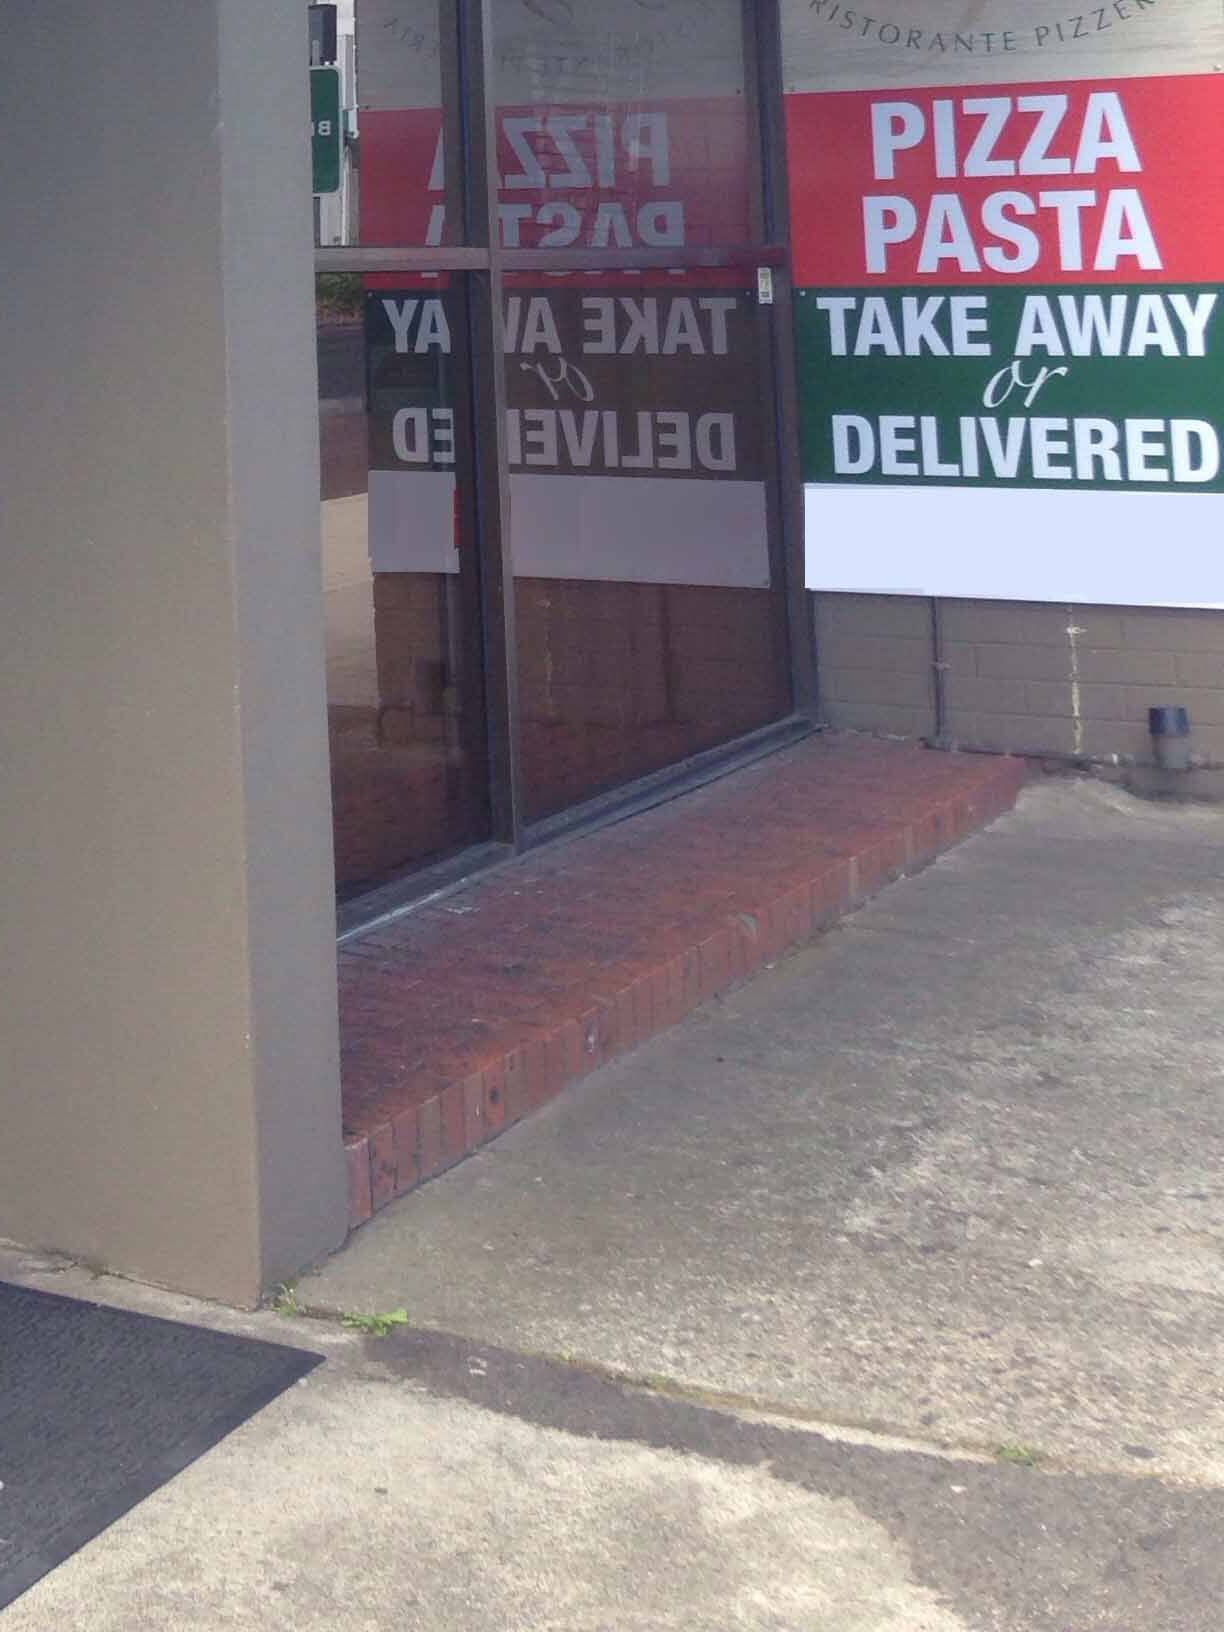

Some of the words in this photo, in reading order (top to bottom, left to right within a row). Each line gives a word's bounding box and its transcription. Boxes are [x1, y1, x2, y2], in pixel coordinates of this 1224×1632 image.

[871, 92, 1142, 180] PIZZA
[862, 189, 1164, 274] PASTA
[816, 295, 991, 357] TAKE
[1015, 294, 1218, 357] AWAY
[982, 359, 1069, 409] or
[832, 414, 1218, 483] DELIVERED
